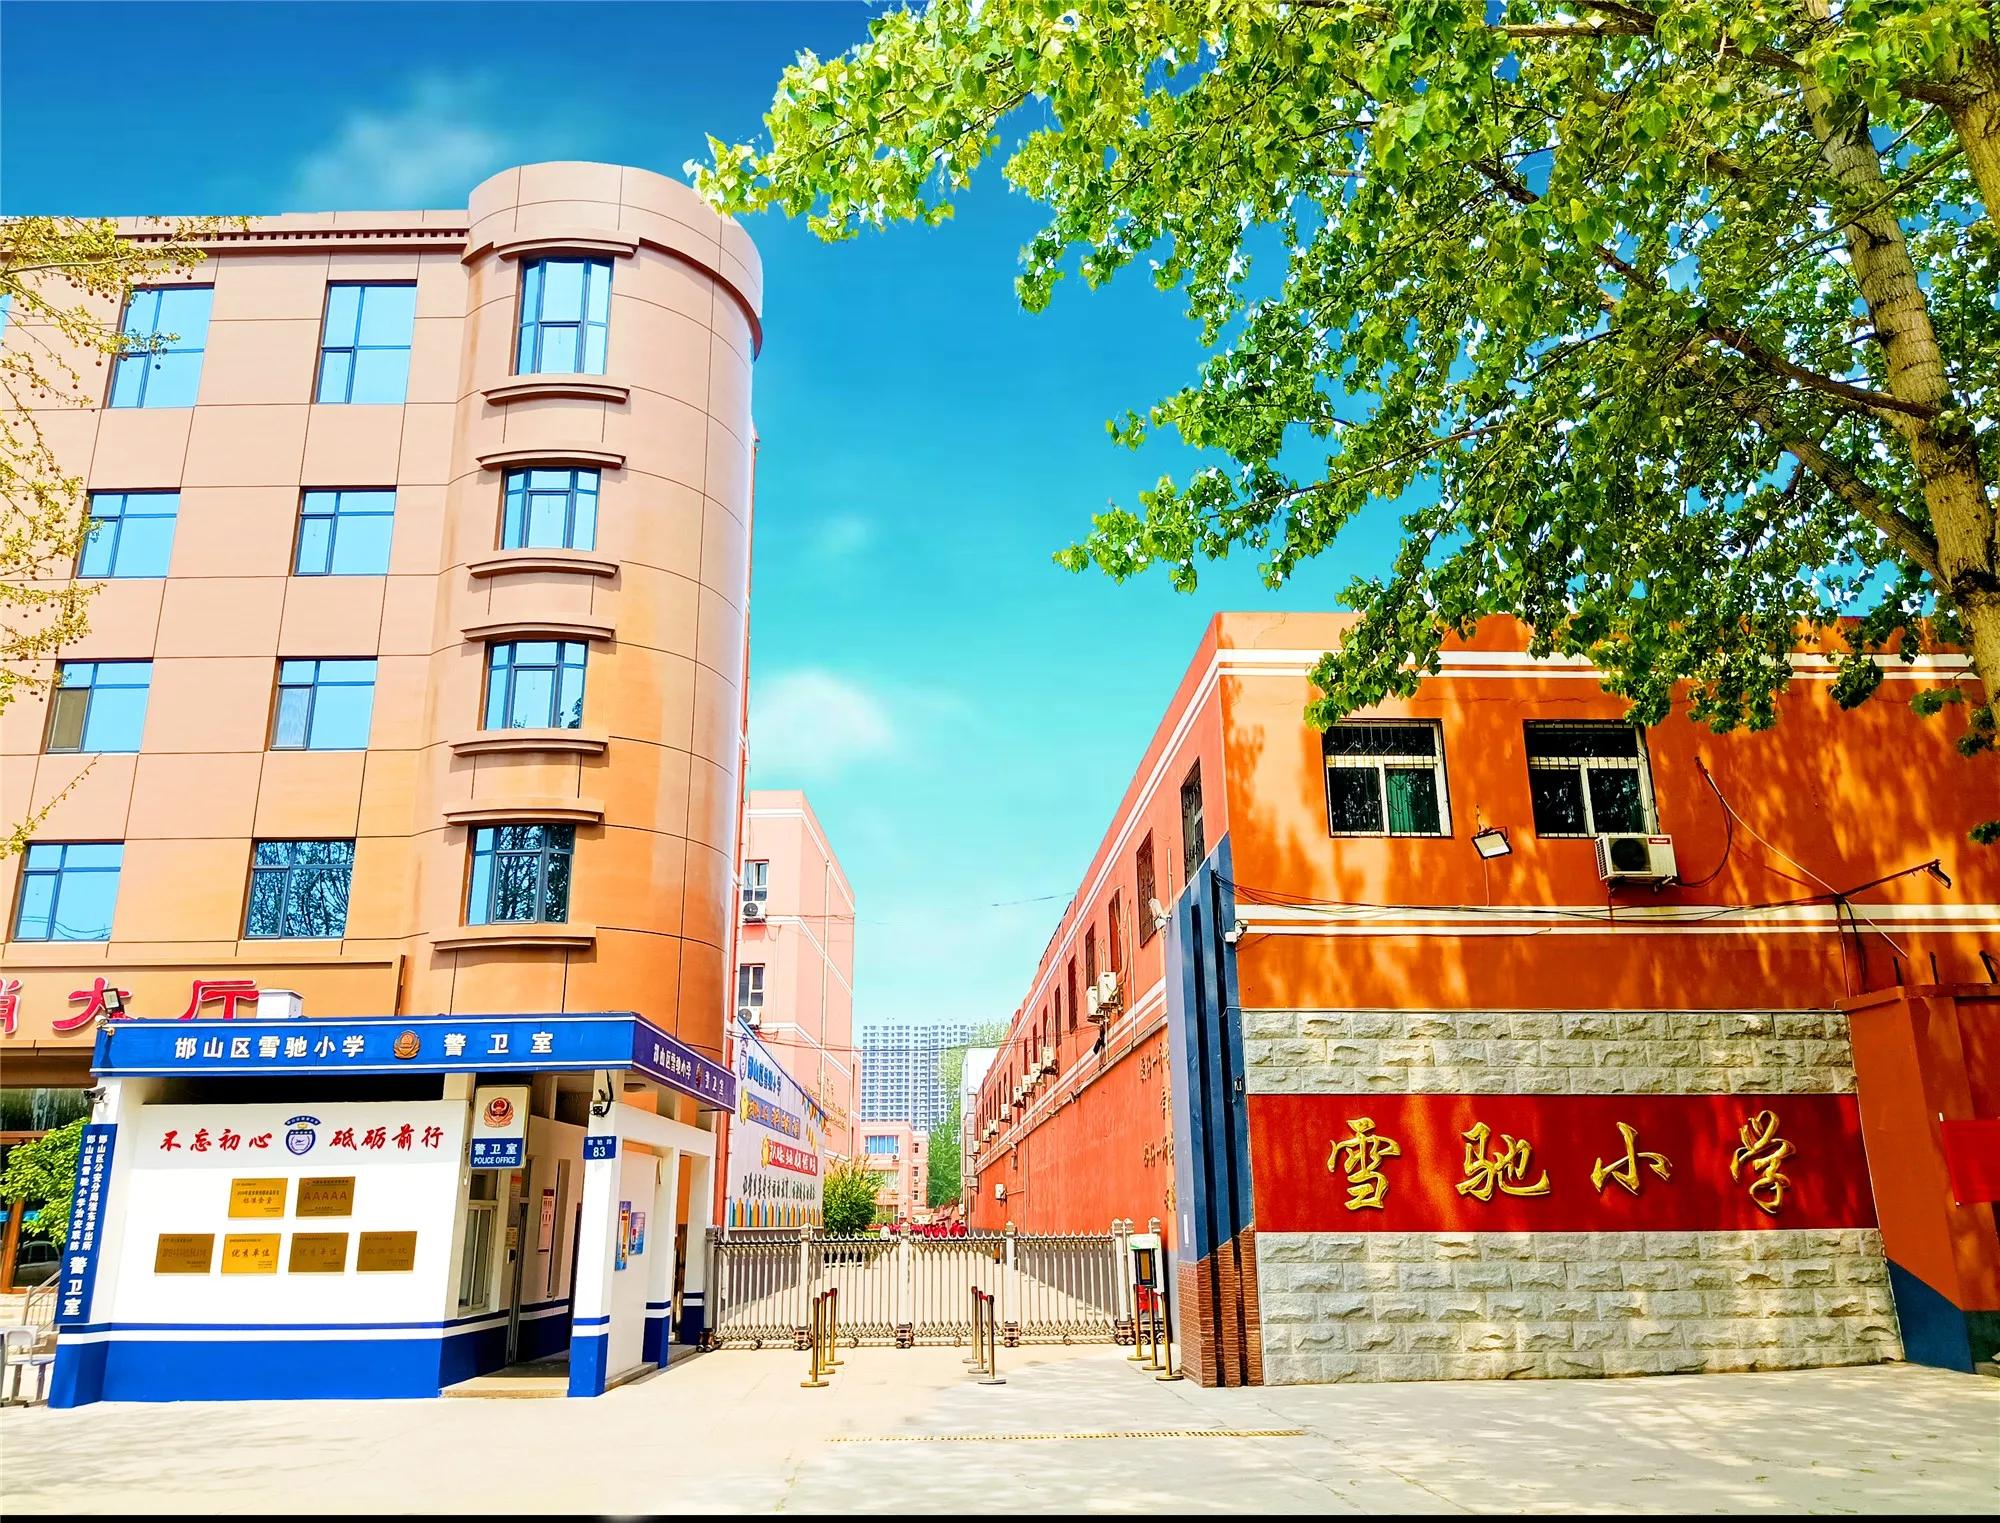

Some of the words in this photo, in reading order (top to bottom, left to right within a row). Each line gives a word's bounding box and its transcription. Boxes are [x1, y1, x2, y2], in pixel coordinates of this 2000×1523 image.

[174, 1034, 365, 1060] 邯山区雪驰小学
[443, 1031, 554, 1057] 警卫室
[159, 1128, 273, 1152] 不忘初心
[328, 1123, 445, 1152] 砥砺前行
[474, 1142, 518, 1156] 警卫室
[592, 1146, 606, 1158] 83
[473, 1156, 495, 1164] POLICE
[495, 1156, 516, 1164] OFFICE
[1327, 1109, 1797, 1215] 雪驰小学
[62, 1255, 88, 1317] 警卫室
